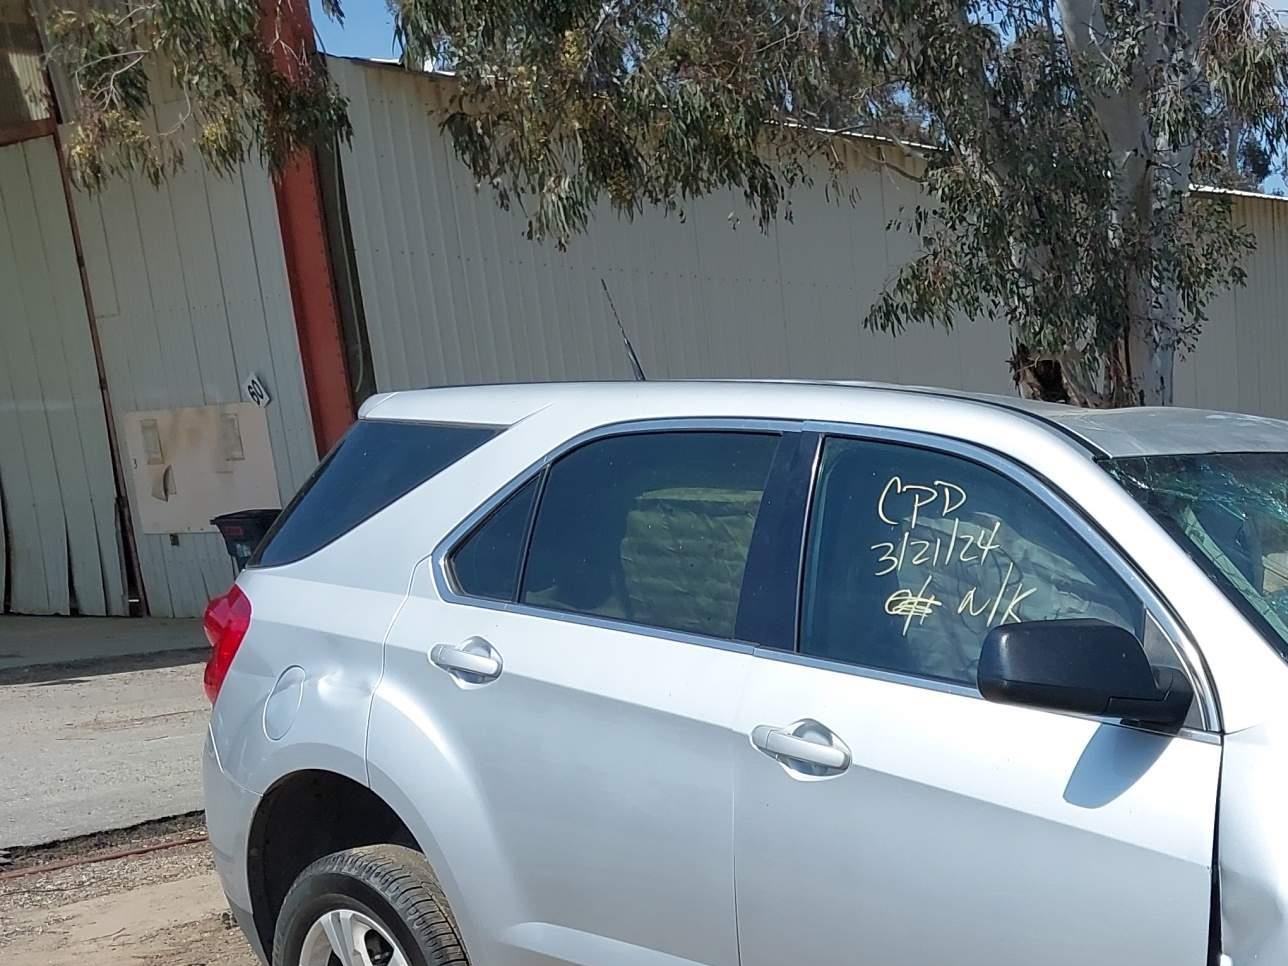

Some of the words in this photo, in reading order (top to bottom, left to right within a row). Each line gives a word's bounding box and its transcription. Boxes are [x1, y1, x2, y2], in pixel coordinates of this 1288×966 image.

[878, 476, 966, 528] CPD
[870, 517, 1001, 576] 3/21/24
[957, 562, 1037, 626] N/K
